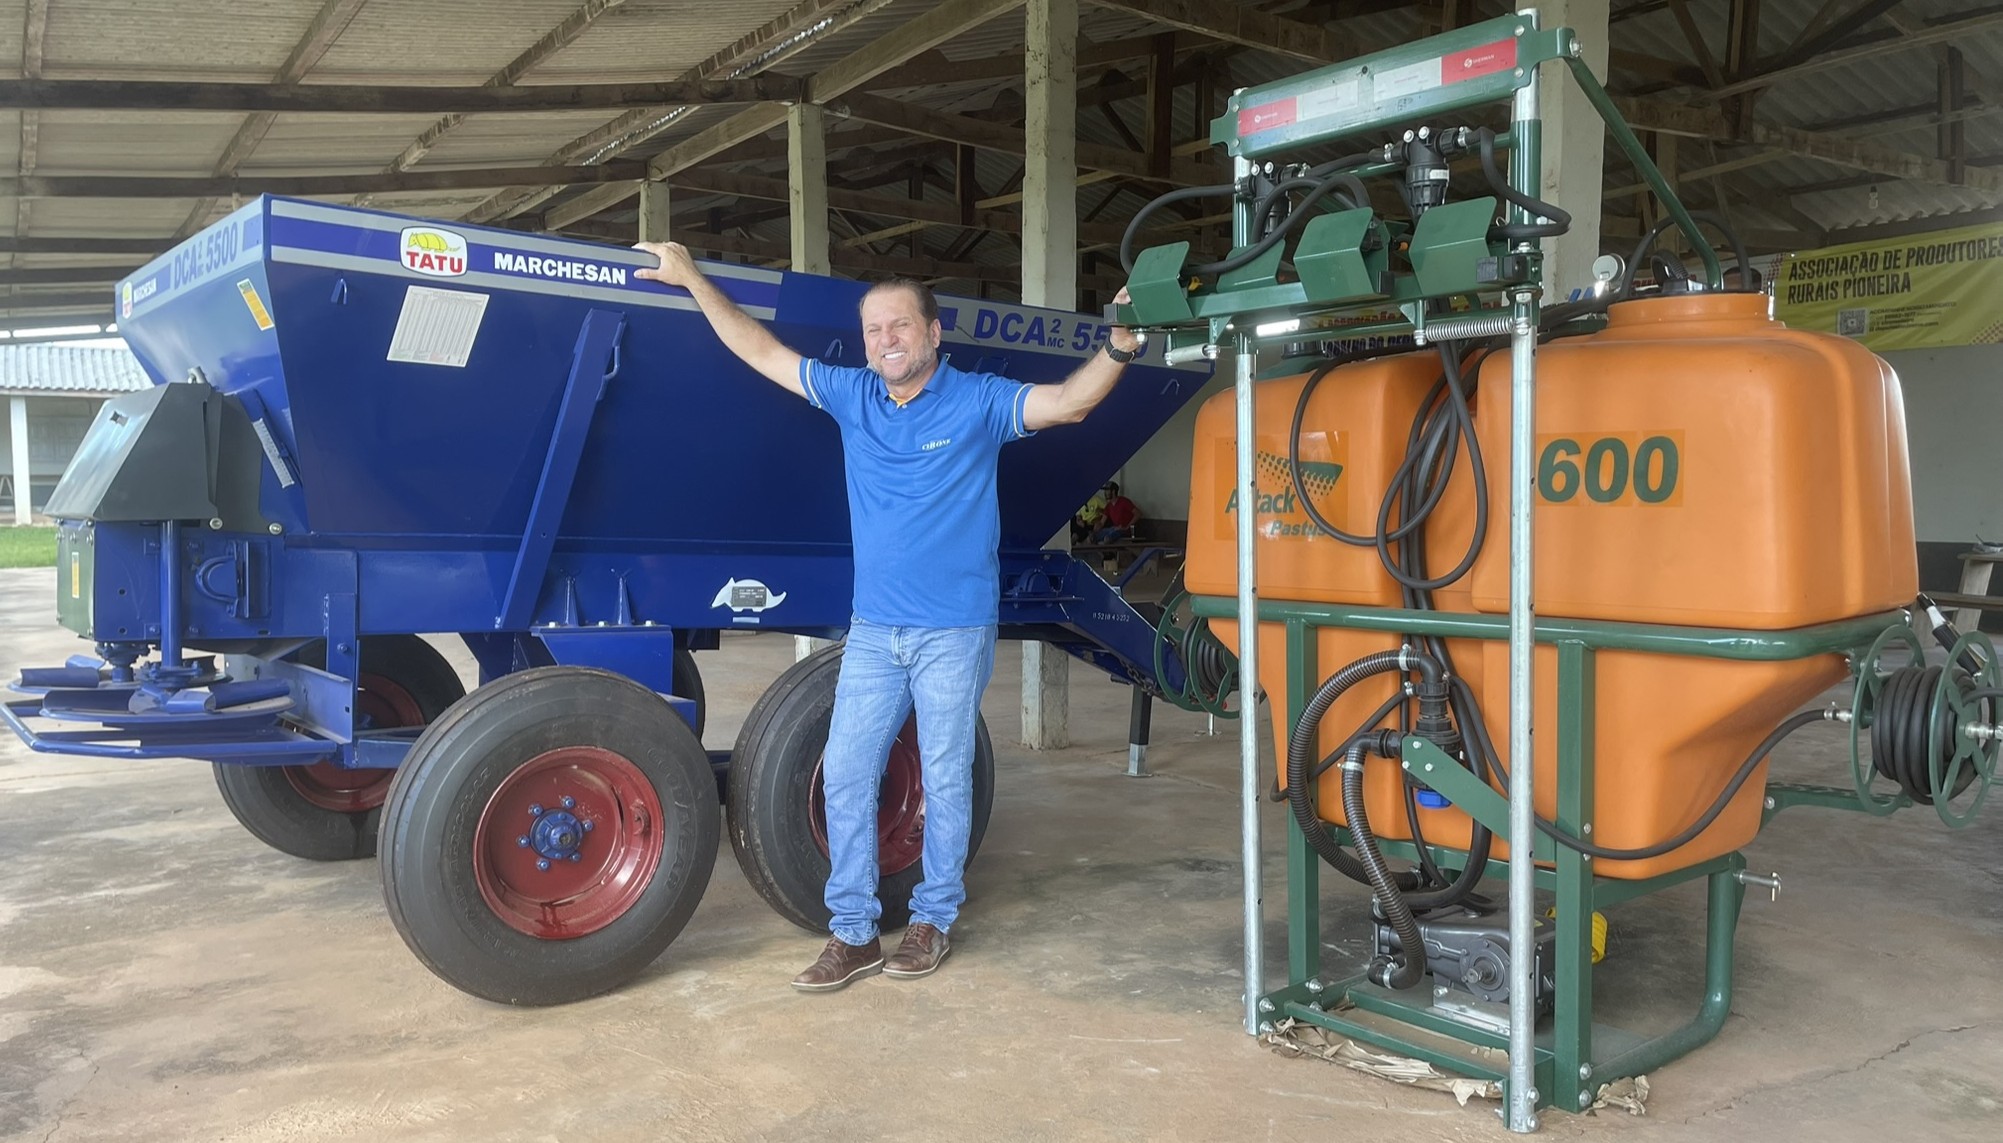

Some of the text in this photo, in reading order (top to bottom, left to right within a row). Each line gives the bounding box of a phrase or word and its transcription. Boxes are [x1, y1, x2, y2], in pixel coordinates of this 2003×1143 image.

[206, 221, 238, 274] 5500
[406, 251, 463, 274] TATU
[494, 252, 626, 286] MARCHESAN
[1788, 251, 1880, 282] ASSOCIAÇÃO
[1883, 249, 1903, 271] DE
[1788, 272, 1911, 304] RURAIS PIONEIRA
[973, 308, 1046, 347] DCA
[1537, 435, 1679, 503] 600
